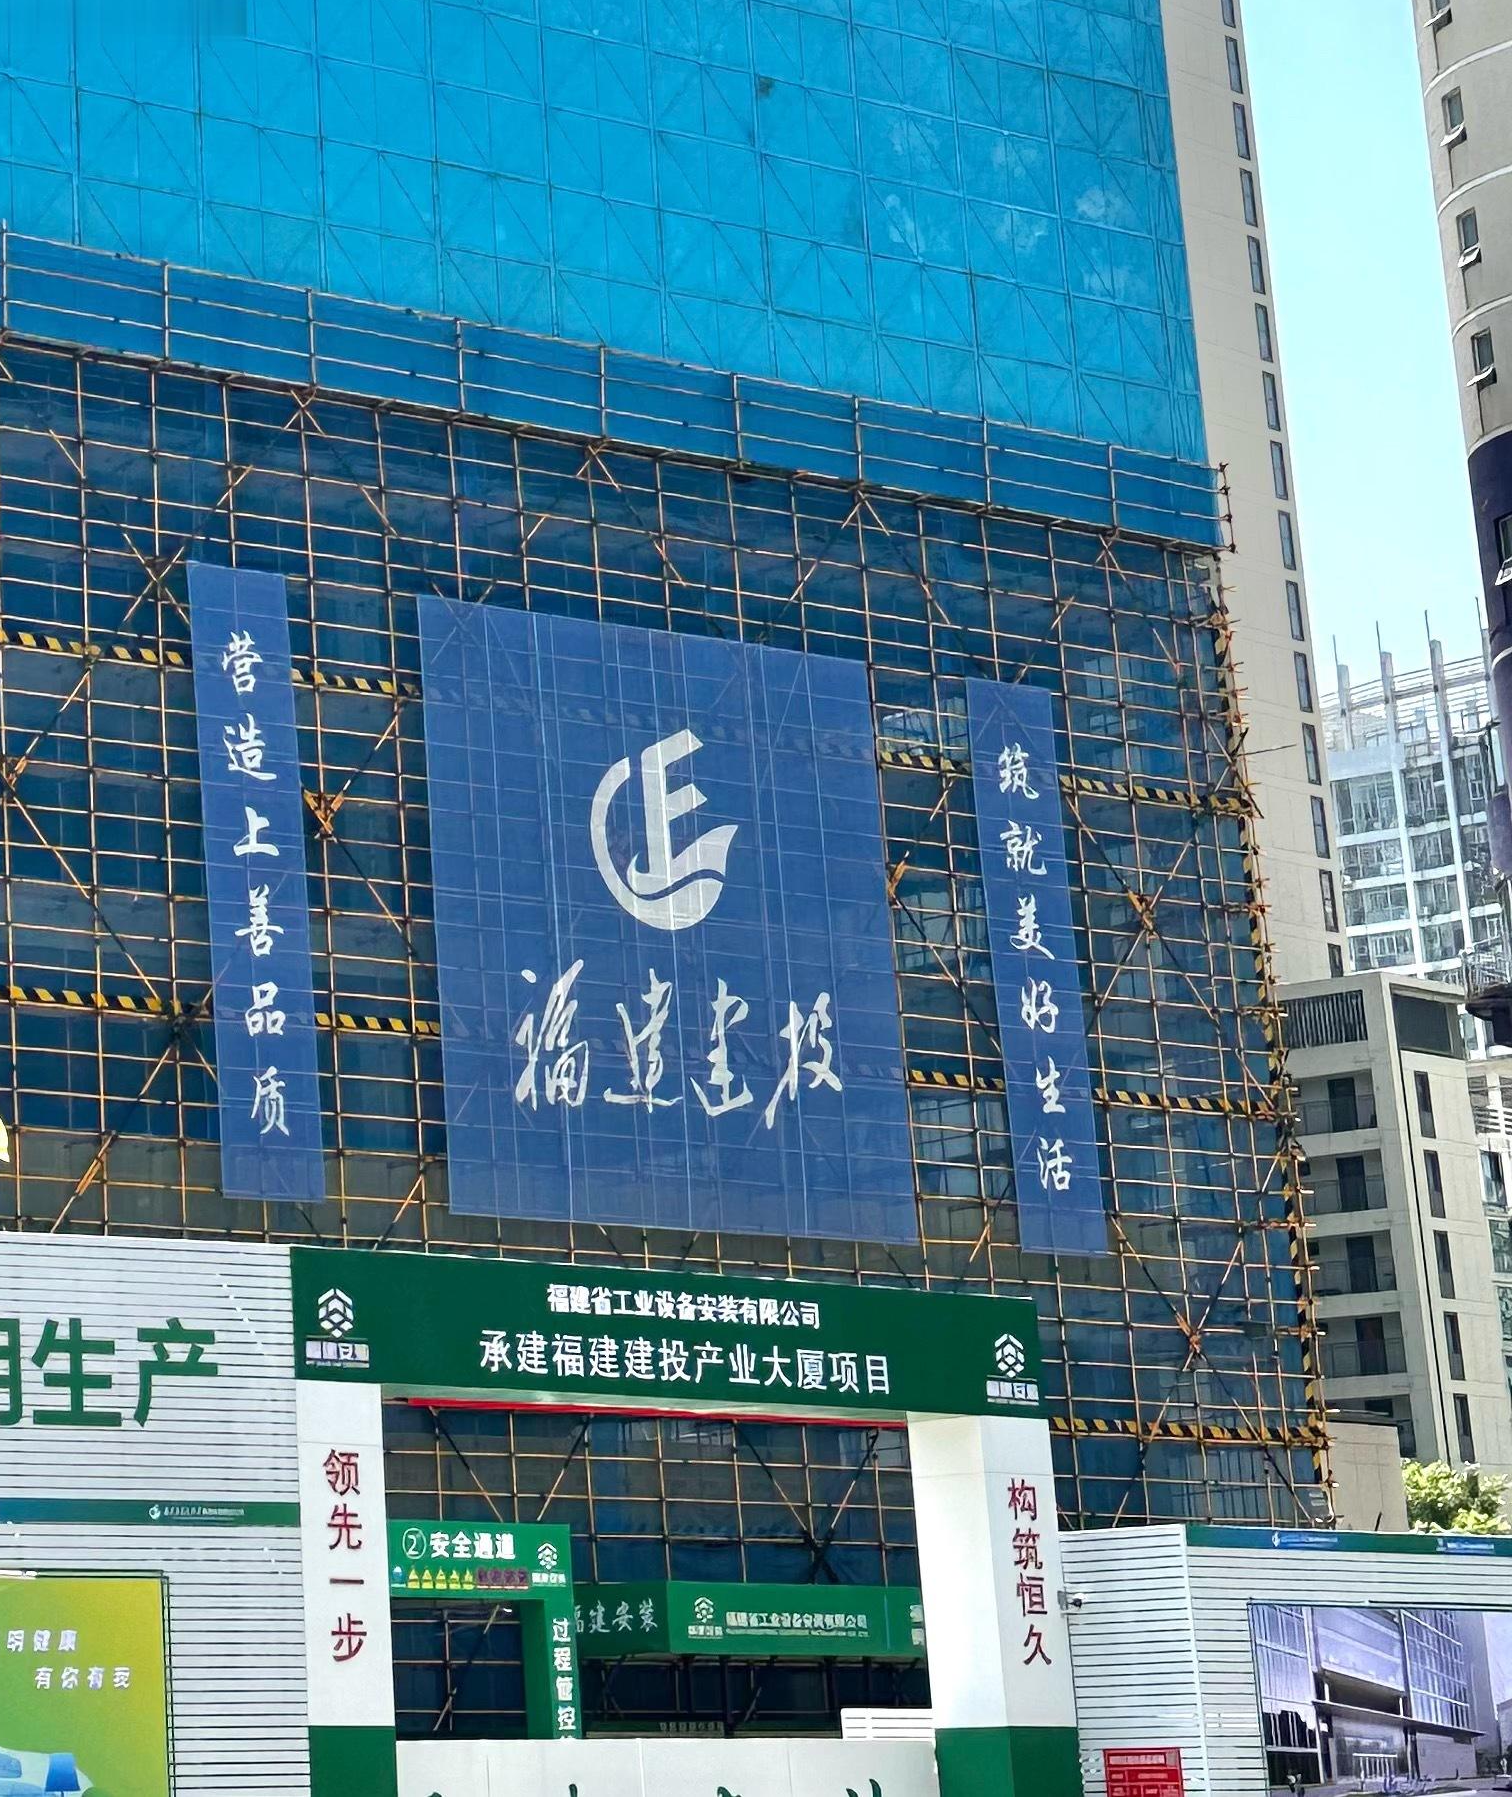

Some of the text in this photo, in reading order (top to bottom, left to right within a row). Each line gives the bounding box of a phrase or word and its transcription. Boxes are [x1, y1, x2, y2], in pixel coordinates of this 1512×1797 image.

[220, 629, 290, 1137] 营造上善品质
[997, 742, 1074, 1194] 筑就美好生活
[479, 1329, 890, 1395] 承建福建建投产业大厦项目
[546, 1283, 820, 1330] 福建省工业设备安装有限公司
[323, 1449, 367, 1662] 领先一步
[1007, 1478, 1052, 1666] 构筑恒久
